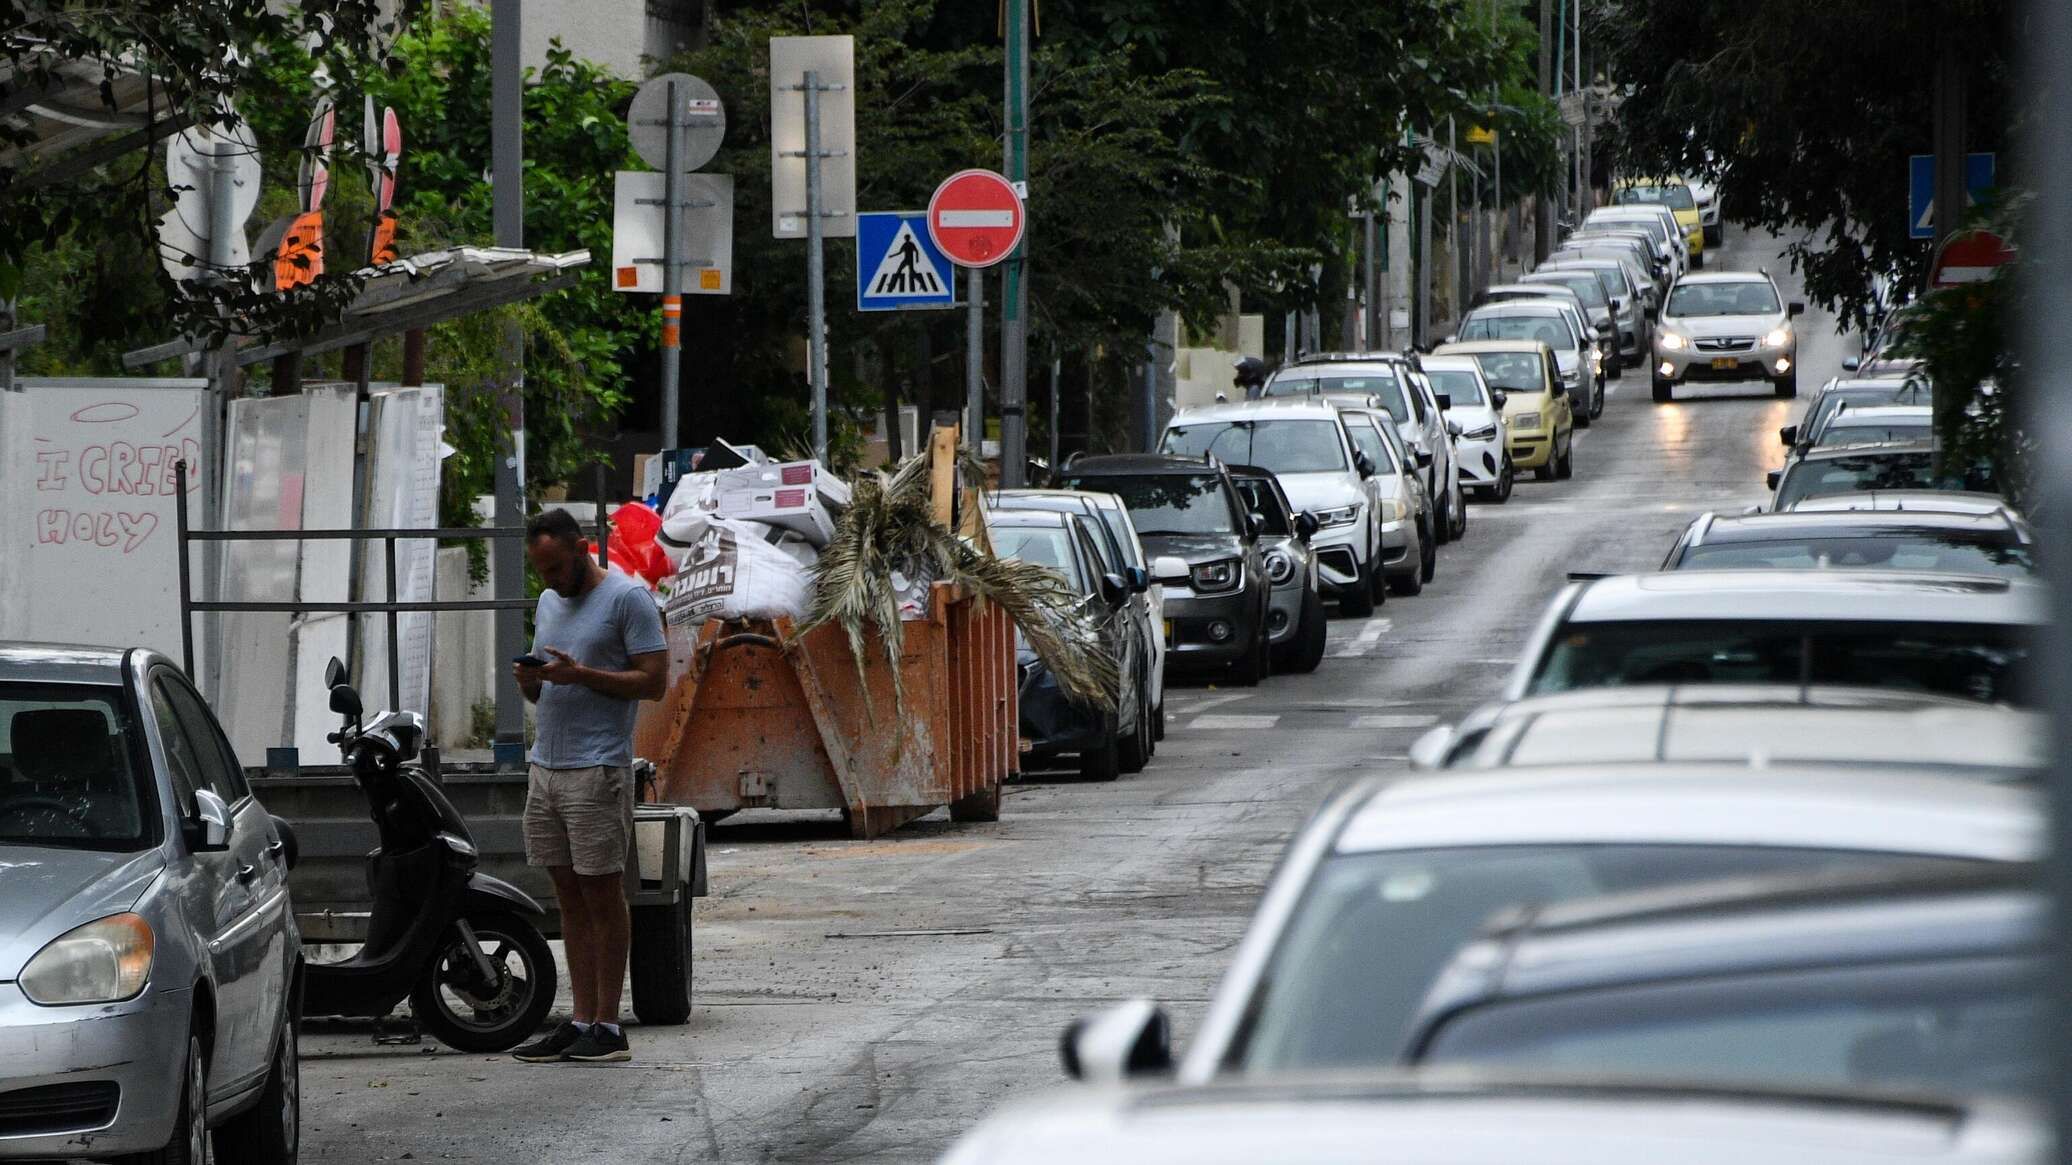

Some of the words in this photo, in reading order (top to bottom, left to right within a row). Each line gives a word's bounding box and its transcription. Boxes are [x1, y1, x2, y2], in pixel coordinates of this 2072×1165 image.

[36, 450, 70, 491] I
[79, 438, 201, 497] CRIED
[37, 509, 159, 554] HOLY
